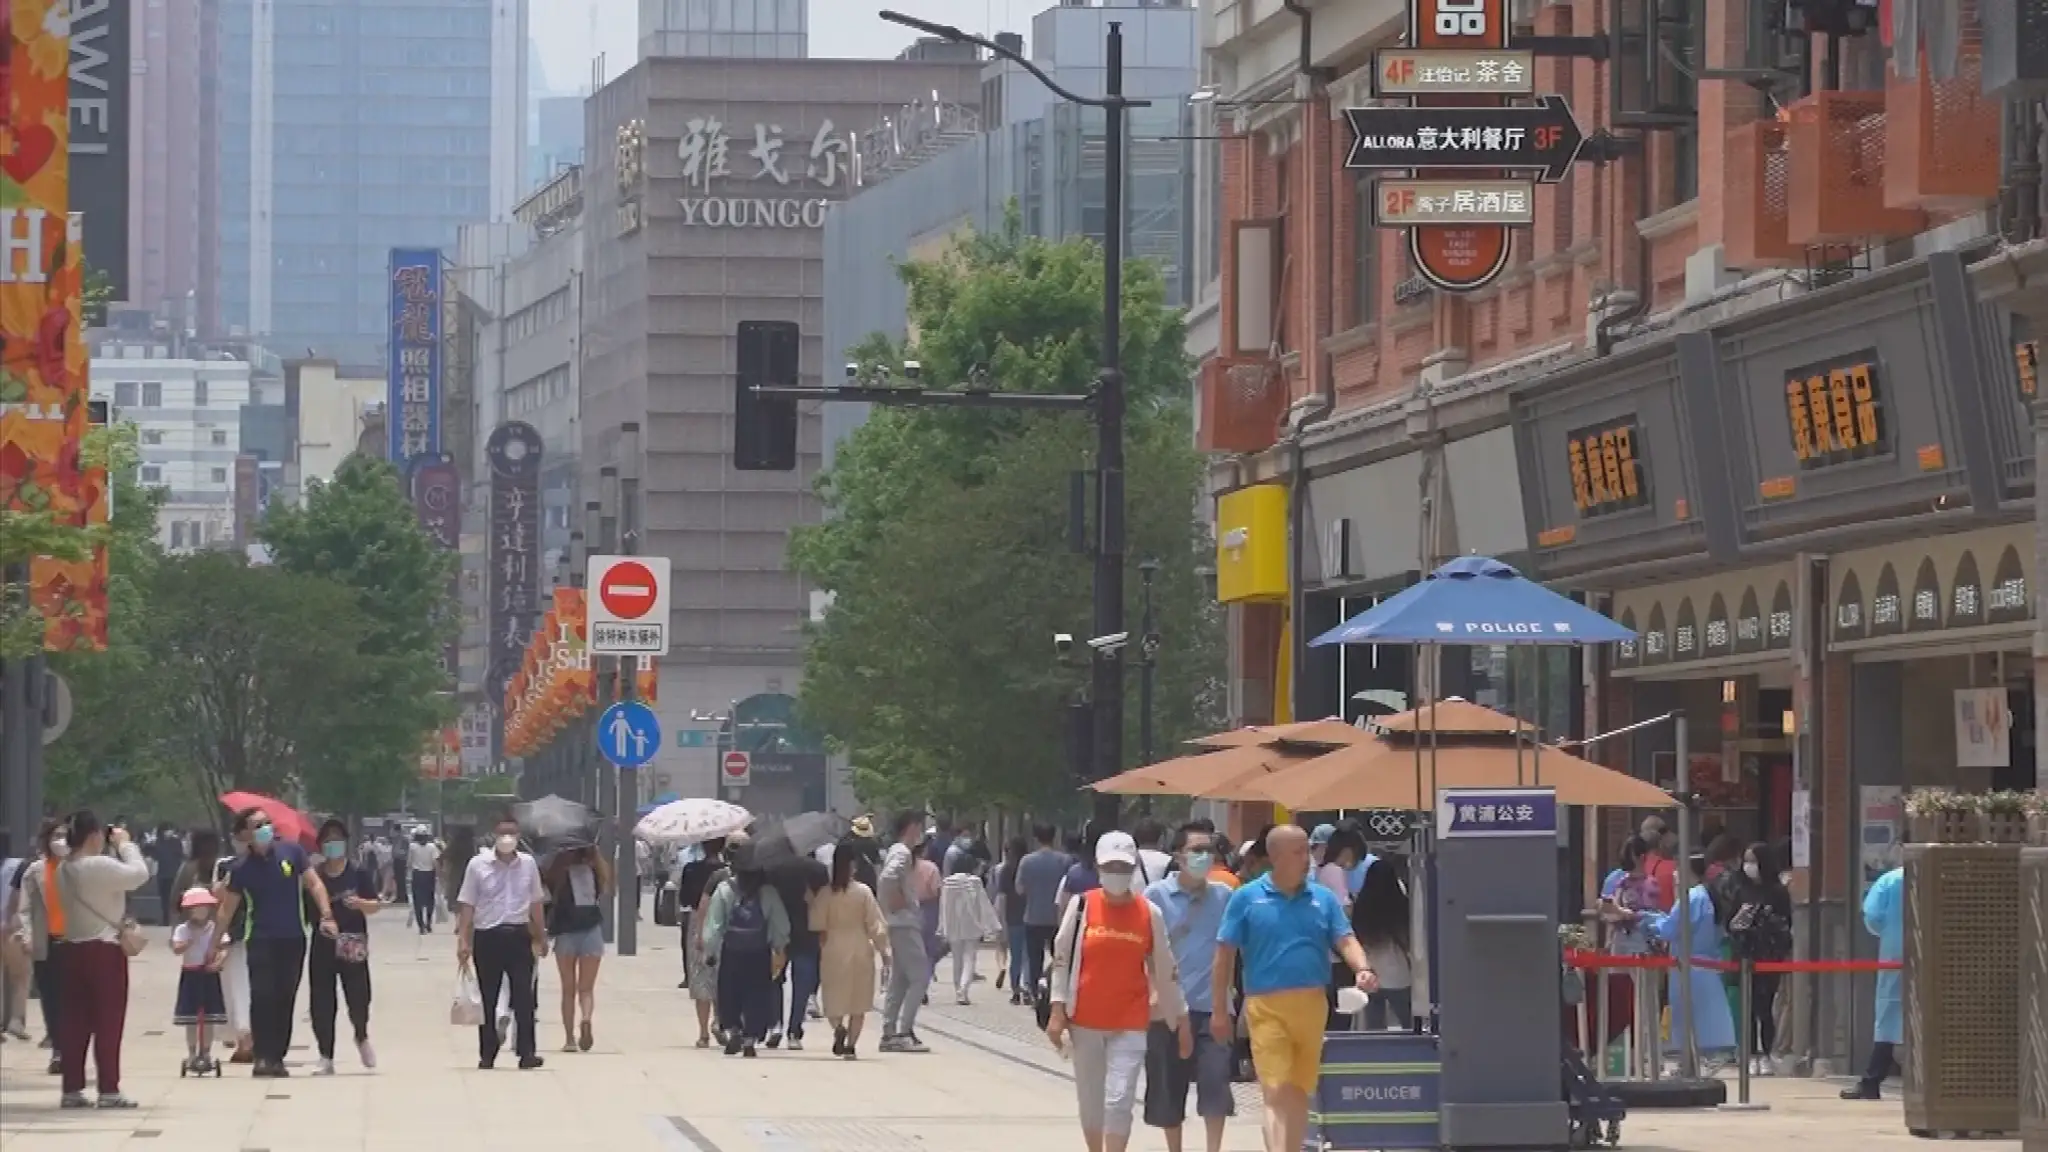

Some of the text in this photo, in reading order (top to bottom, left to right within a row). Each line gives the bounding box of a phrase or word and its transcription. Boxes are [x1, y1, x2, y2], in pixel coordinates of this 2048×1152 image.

[1385, 59, 1415, 84] 4F
[1476, 60, 1524, 83] 茶舍
[1363, 127, 1563, 150] ALLORA 意大利餐厅 3F
[678, 115, 848, 194] 雅戈尔
[1386, 190, 1416, 215] 2F
[1465, 622, 1544, 634] POLICE
[1459, 804, 1534, 823] 黄浦公安
